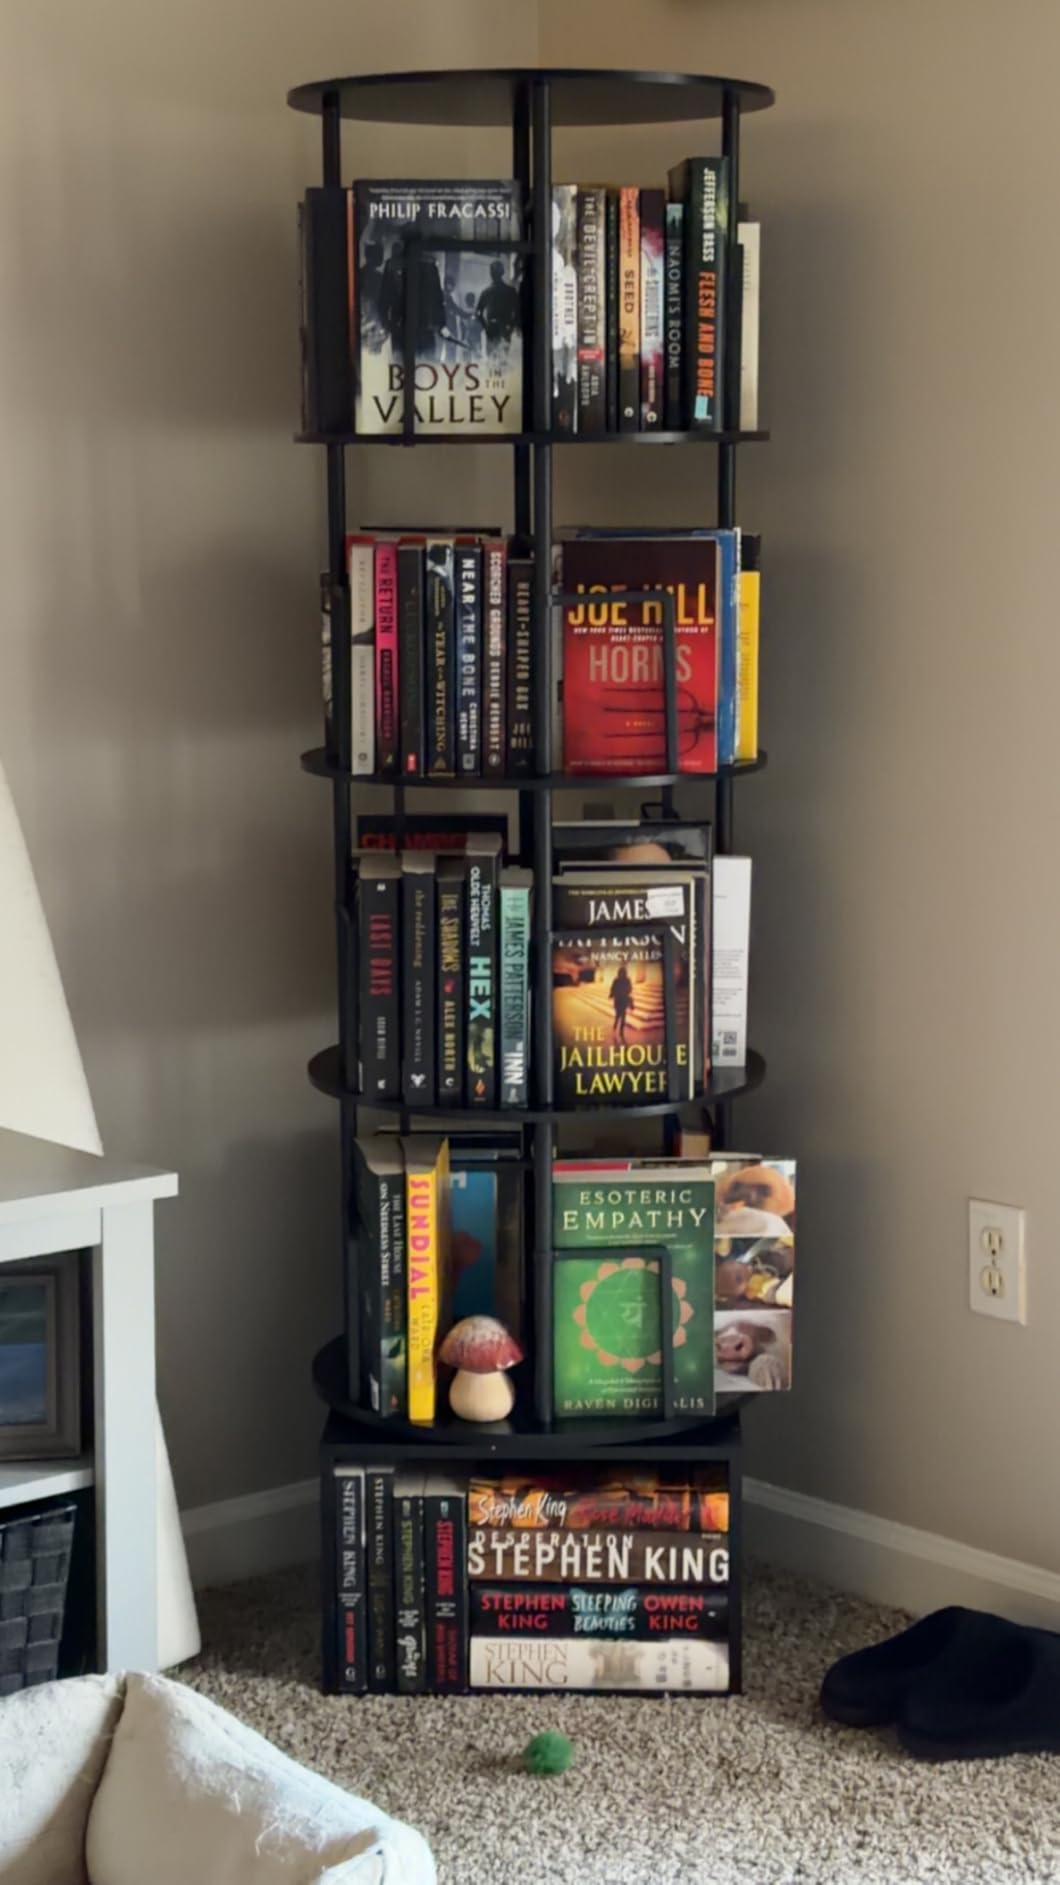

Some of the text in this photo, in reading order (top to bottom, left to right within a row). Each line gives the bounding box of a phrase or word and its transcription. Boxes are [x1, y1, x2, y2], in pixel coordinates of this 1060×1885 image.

[369, 202, 511, 222] PHILIP FRACASSI
[584, 197, 595, 217] THE
[703, 167, 715, 262] JEFFERSON BASS
[583, 223, 597, 264] DEVIL
[583, 275, 597, 321] CREPT
[624, 269, 634, 314] SEED
[668, 245, 682, 369] NAOMI'S ROOM
[584, 328, 597, 345] IN
[696, 271, 716, 397] FLESH AND BONE
[388, 363, 480, 392] BOYS
[489, 551, 502, 605] SCORCHED
[380, 578, 393, 634] RETURN
[567, 583, 715, 626] JOE HLL
[461, 558, 475, 697] NEAR THE BONE
[489, 609, 502, 657] GROUNDS
[516, 582, 530, 680] HEART-SHAPED
[435, 631, 447, 667] YEAR
[588, 644, 692, 684] HORNS
[435, 680, 447, 752] WITCHING
[469, 702, 477, 751] CHRISTINA
[470, 866, 480, 946] OLDE HEUVELT
[481, 883, 491, 931] THOMAS
[413, 890, 426, 968] the reddening
[441, 893, 460, 972] THE SHADOWS
[504, 916, 525, 958] JAMES
[370, 914, 392, 996] LAST DAYS
[590, 951, 630, 961] NANCY
[469, 956, 491, 1020] HEX
[504, 963, 525, 1040] PATTERSON
[444, 1000, 455, 1072] ALEX NORTH
[574, 1026, 605, 1041] THE
[504, 1052, 524, 1085] INN
[559, 1044, 687, 1071] JAILHOUE
[579, 1190, 693, 1206] ESOTERIC
[380, 1182, 389, 1287] ON NEEDLESS STREET
[393, 1214, 403, 1238] LAST
[409, 1179, 431, 1300] SUNDIAL
[563, 1207, 707, 1231] EMPATHY
[563, 1397, 705, 1410] RAVEN DIGILIS
[343, 1480, 356, 1544] STEPHEN
[374, 1477, 384, 1565] STEPHEN KING
[476, 1493, 568, 1527] Stephen King
[401, 1519, 413, 1572] STEPHEN
[436, 1520, 454, 1569] STEPHEN
[474, 1532, 635, 1549] DESPERATION
[342, 1550, 356, 1588] KING
[436, 1569, 453, 1596] KING
[468, 1543, 730, 1582] STEPHEN KING
[402, 1575, 413, 1604] KING
[480, 1593, 566, 1611] STEPHEN
[571, 1593, 638, 1613] SLEEPING
[643, 1594, 704, 1612] OWEN
[498, 1614, 549, 1630] KING
[573, 1615, 636, 1632] BEAUTIES
[648, 1614, 699, 1630] KING
[484, 1642, 569, 1661] STEPHEN
[485, 1660, 569, 1685] KING
